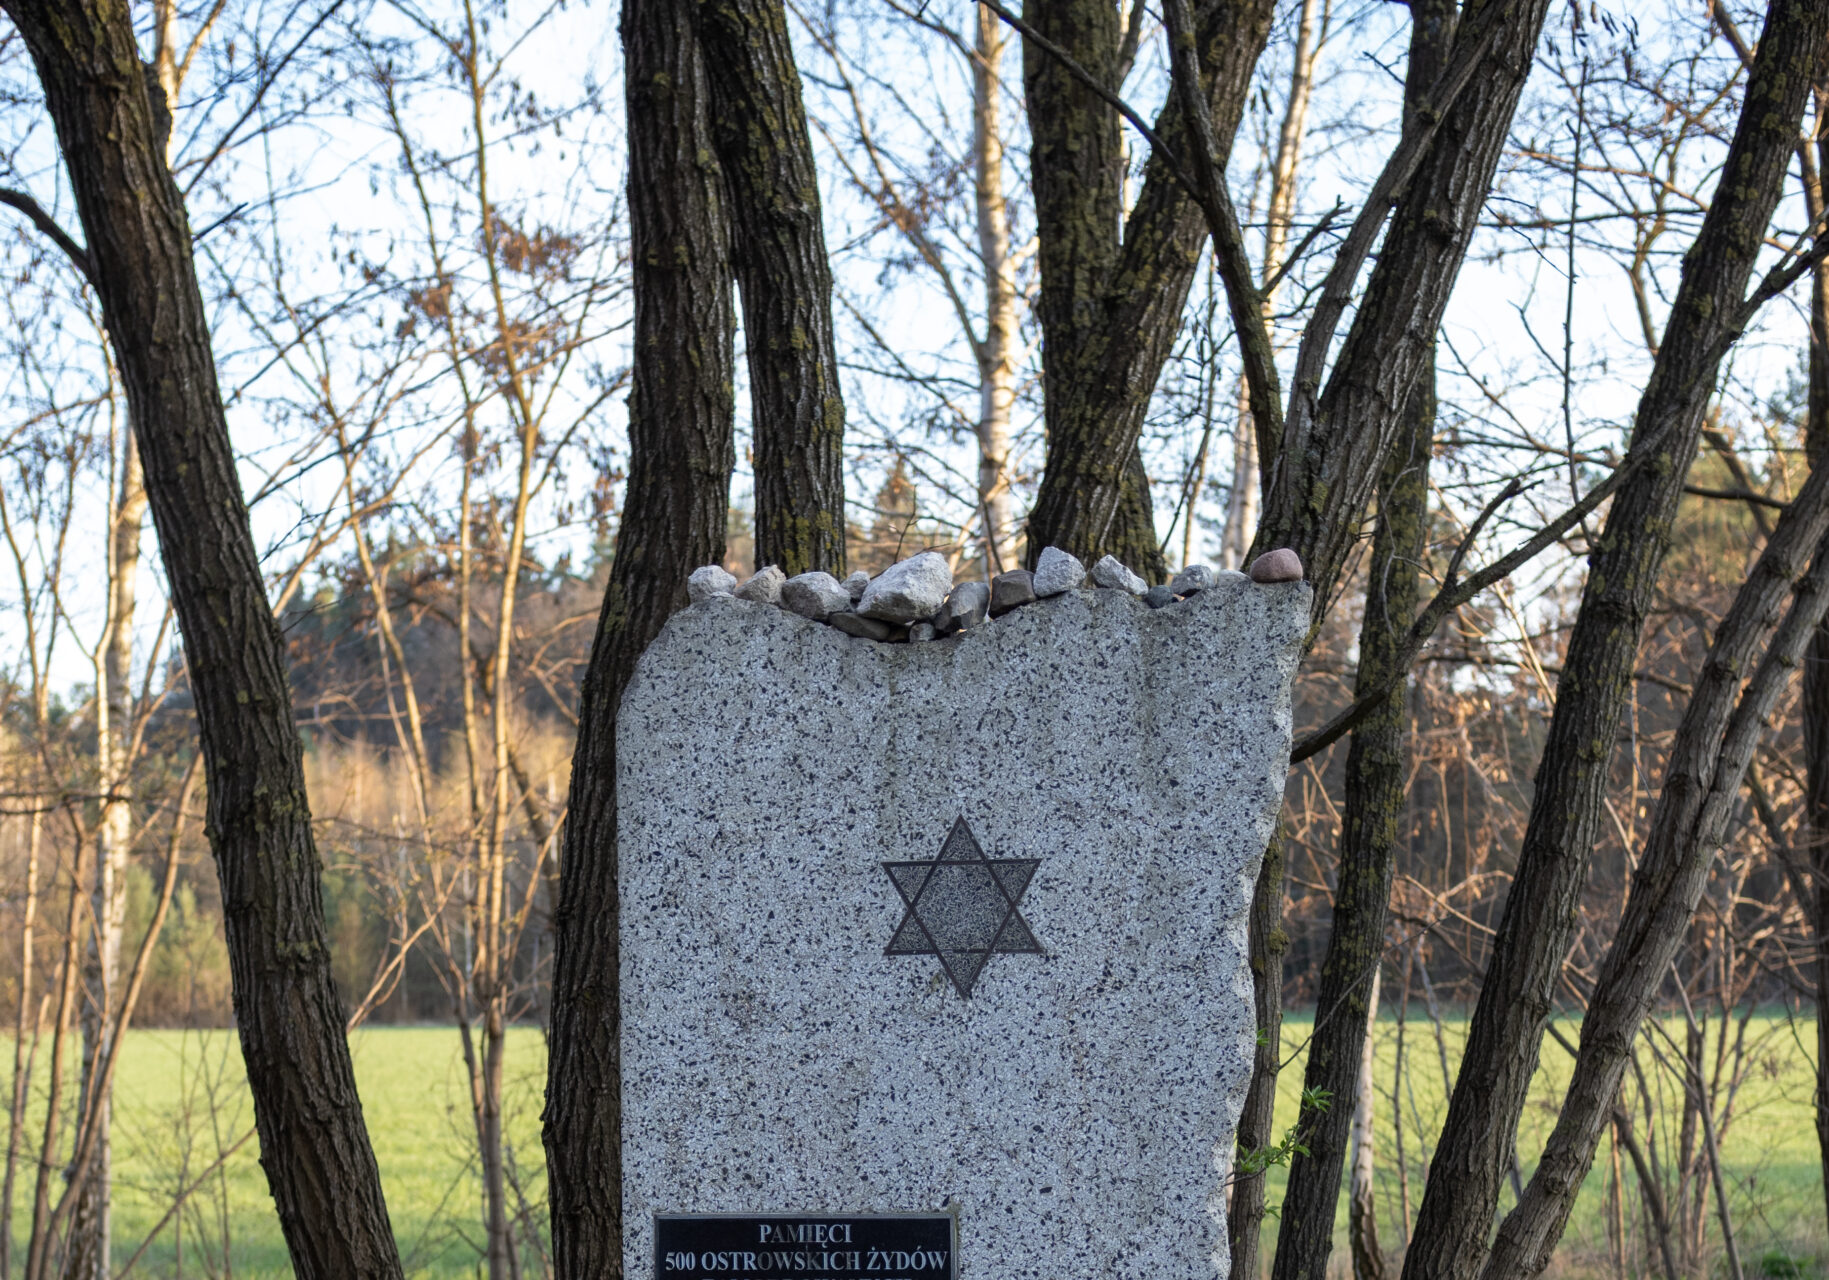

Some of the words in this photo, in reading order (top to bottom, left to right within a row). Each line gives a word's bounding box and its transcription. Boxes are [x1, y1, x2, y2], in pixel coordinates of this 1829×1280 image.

[759, 1224, 852, 1248] PAMIĘCI
[665, 1251, 696, 1271] 500
[701, 1251, 861, 1271] OSTROWSKICH
[866, 1246, 948, 1271] ŻYDÓW
